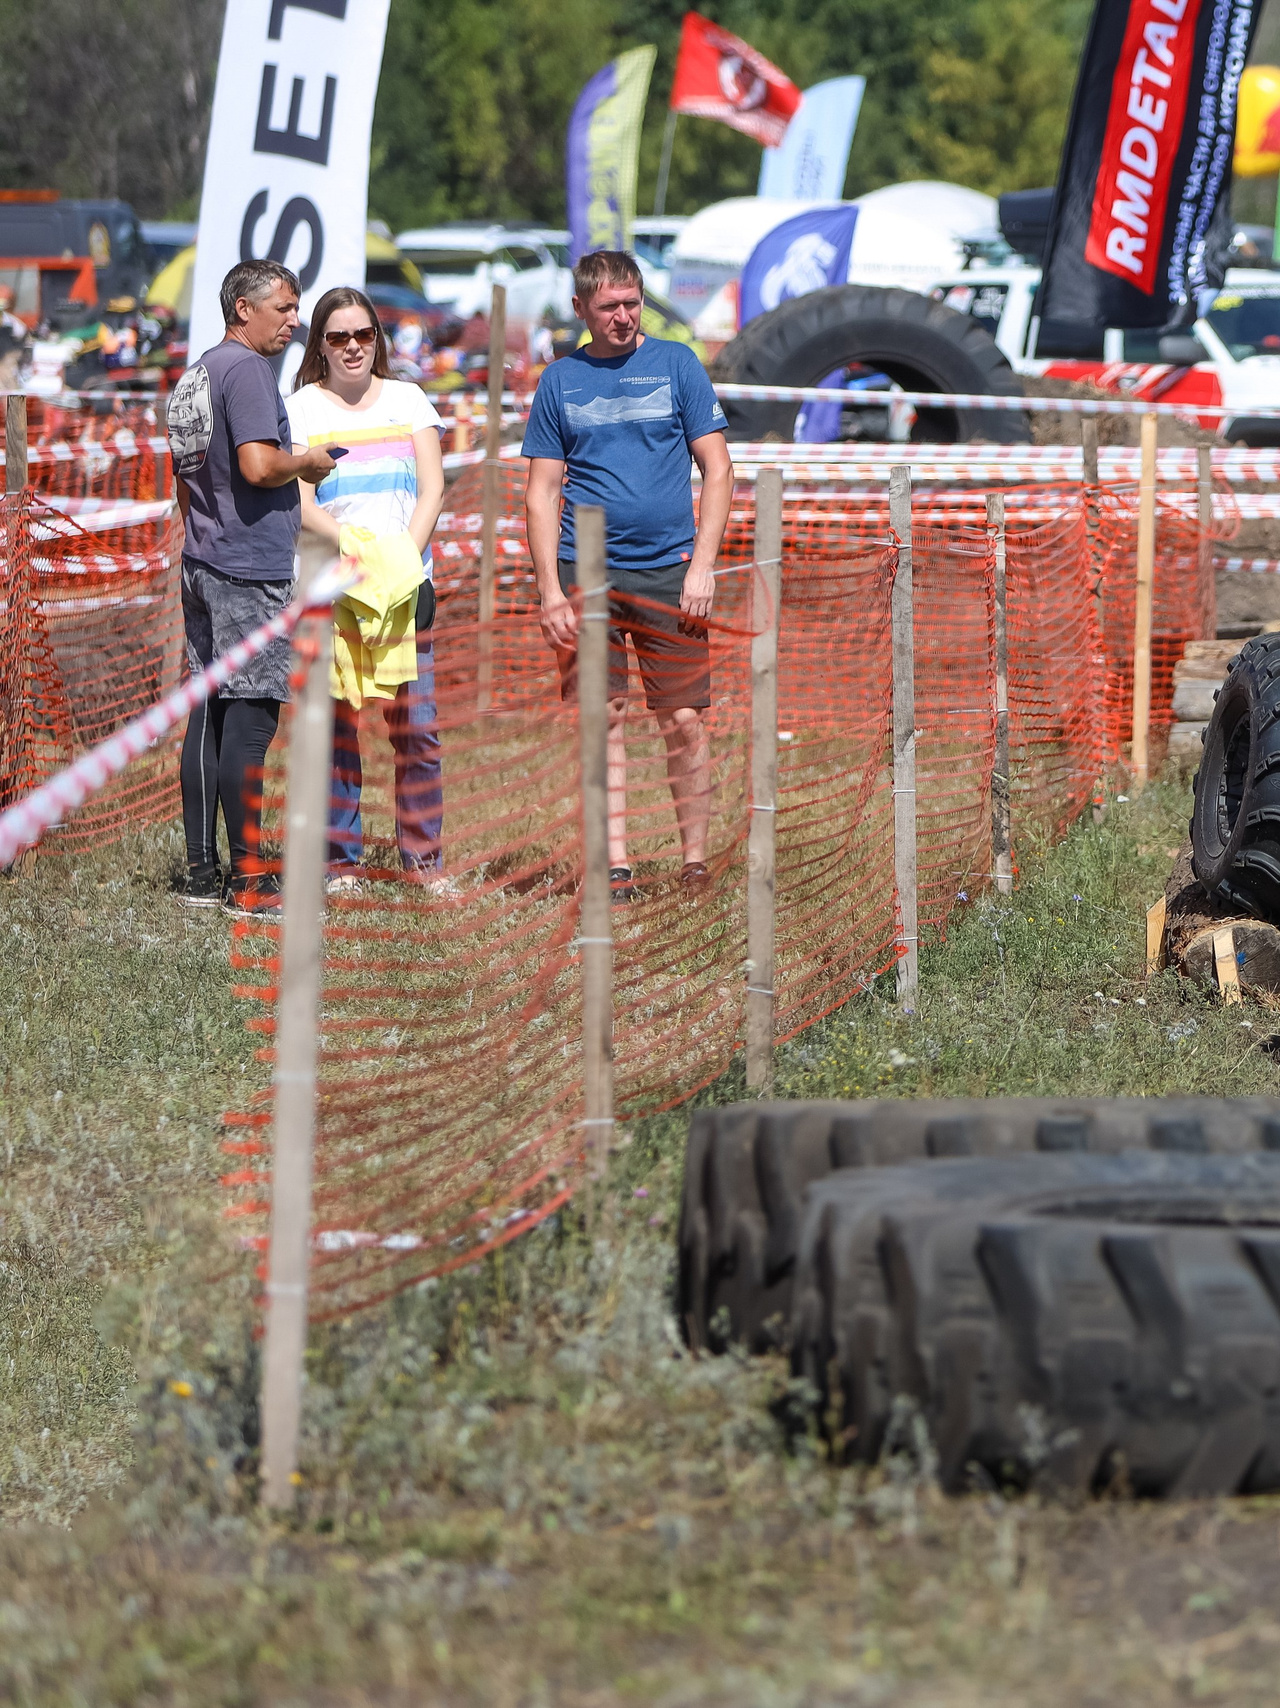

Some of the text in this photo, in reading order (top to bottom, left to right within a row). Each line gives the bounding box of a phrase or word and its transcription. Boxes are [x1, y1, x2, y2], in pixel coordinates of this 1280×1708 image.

[240, 0, 347, 340] SET
[1105, 0, 1188, 274] RMDETAL
[1182, 135, 1213, 200] ЧАСТИ
[1198, 94, 1218, 138] ДЛЯ
